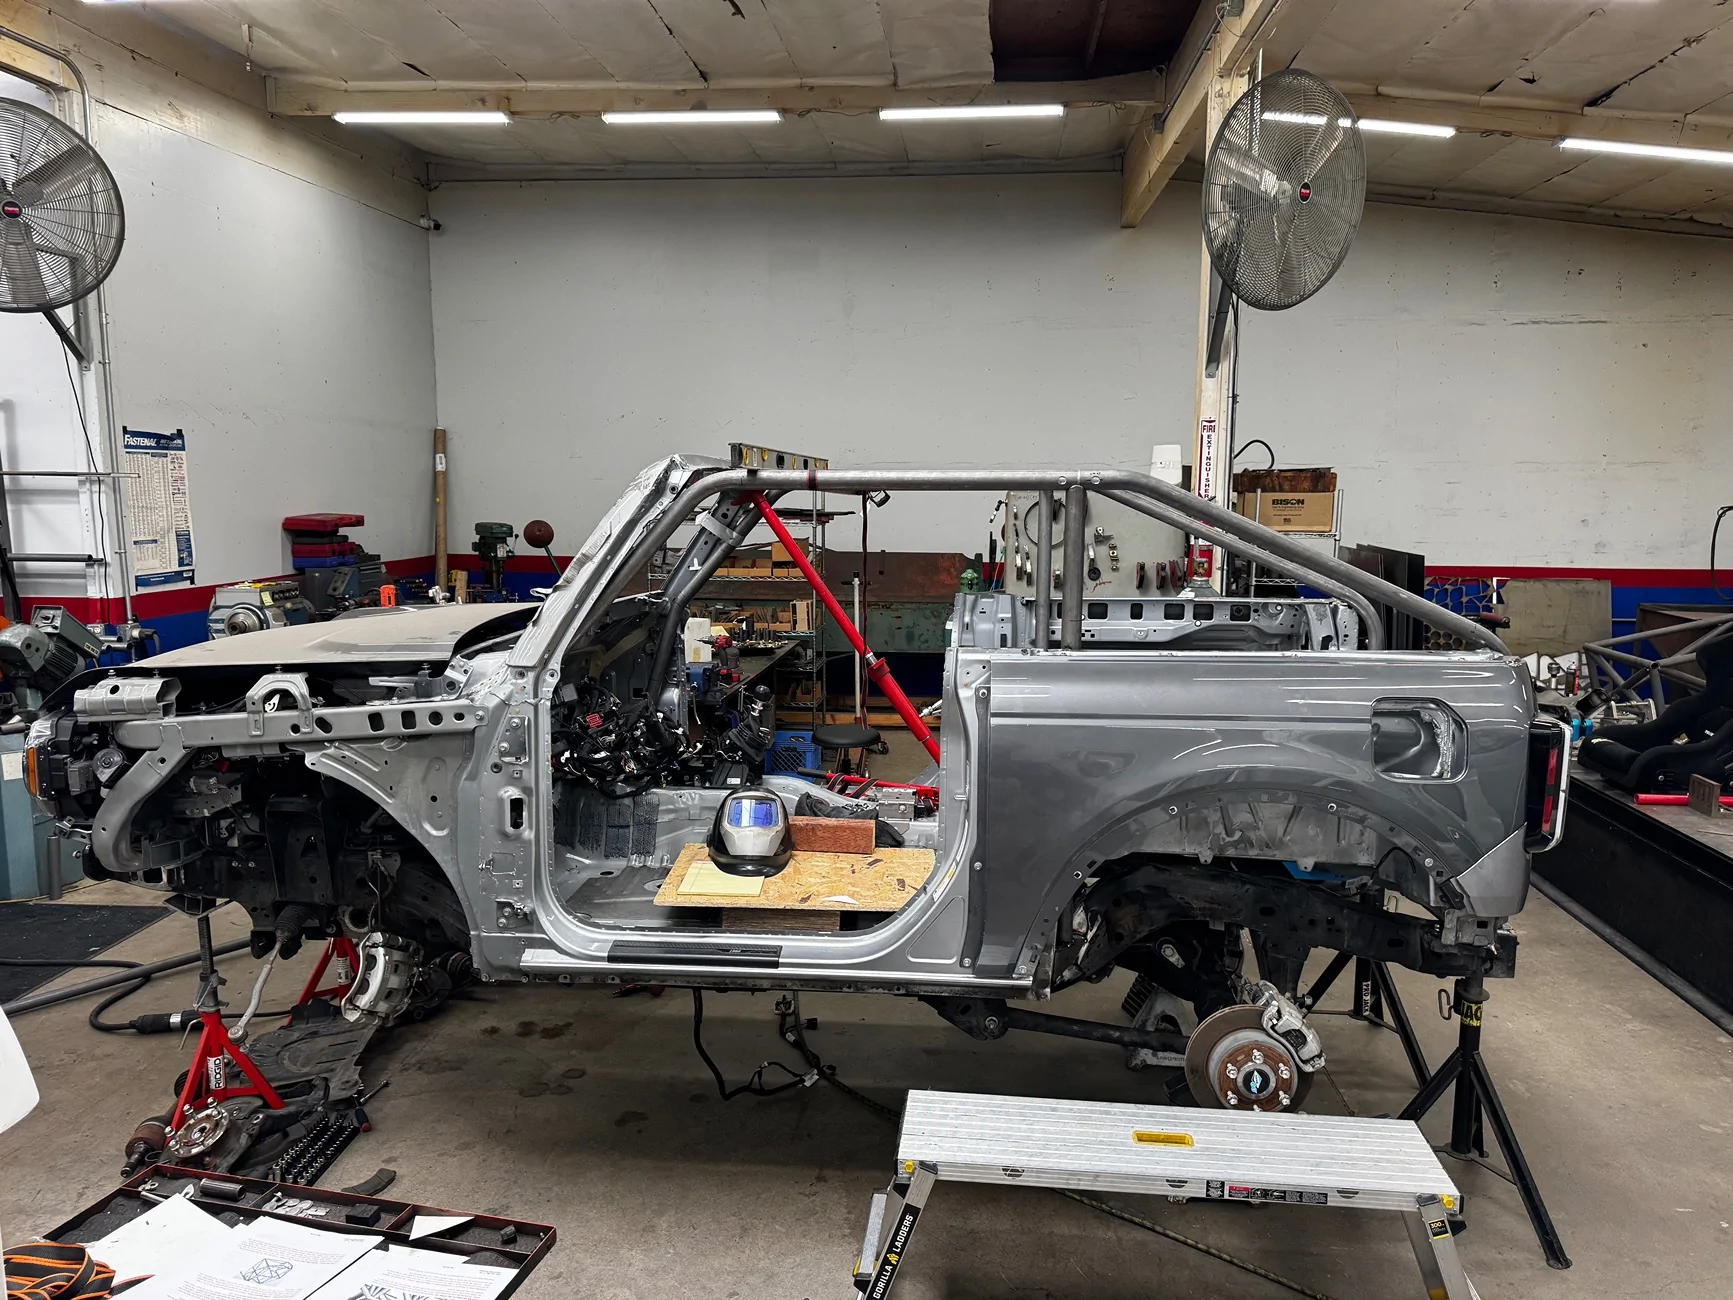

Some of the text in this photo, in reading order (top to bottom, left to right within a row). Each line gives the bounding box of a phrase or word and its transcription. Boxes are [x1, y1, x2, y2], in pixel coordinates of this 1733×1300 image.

[124, 434, 157, 447] FASTENAL
[1204, 434, 1212, 498] EXTINGUISHER
[1271, 498, 1305, 506] BISON
[213, 1057, 222, 1089] RIDGID
[873, 1214, 913, 1299] GORILLA LADDERS
